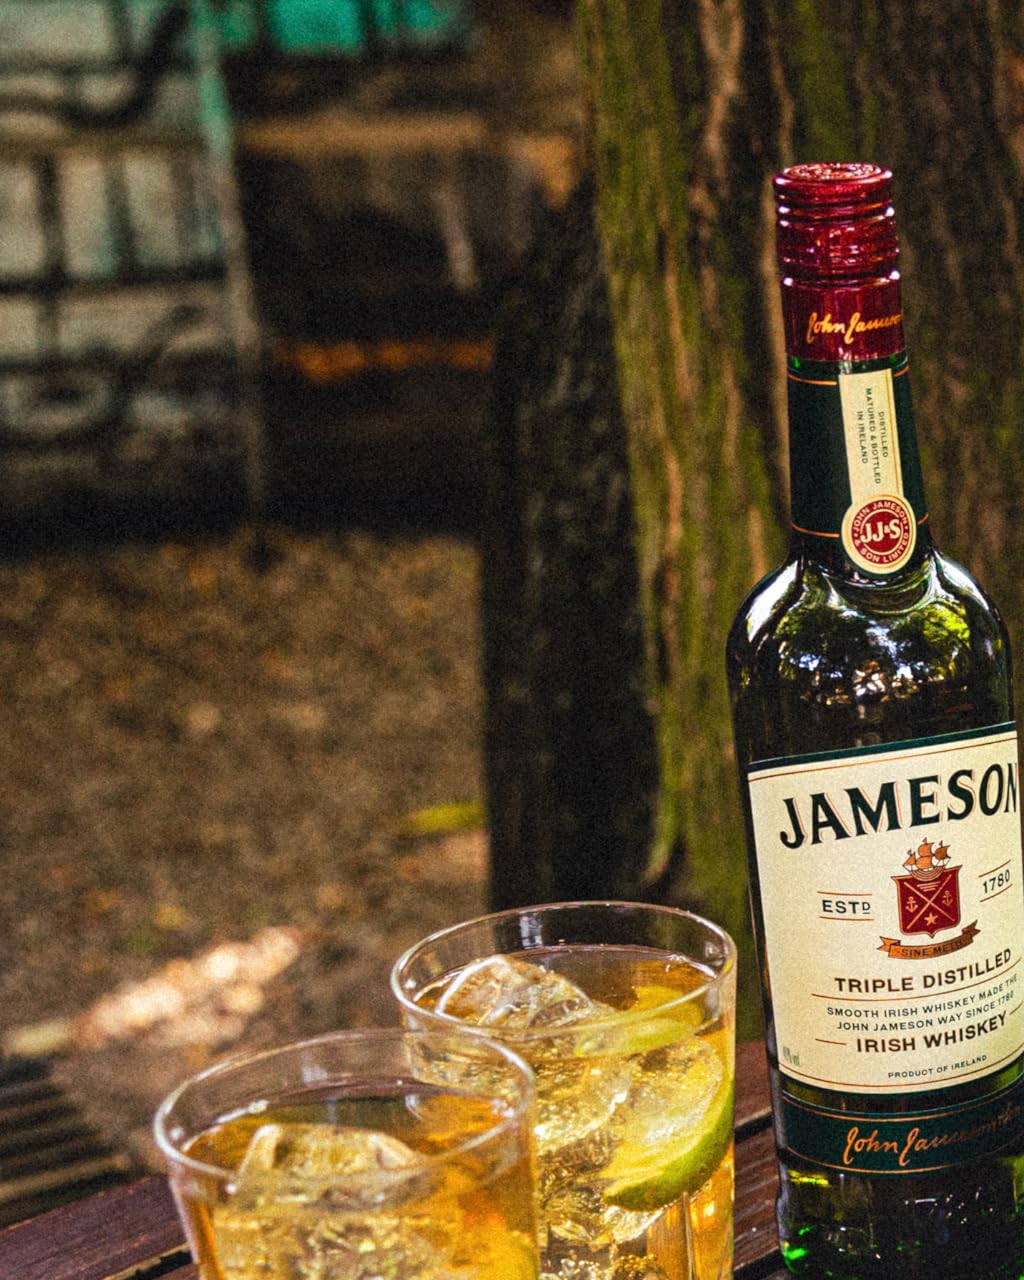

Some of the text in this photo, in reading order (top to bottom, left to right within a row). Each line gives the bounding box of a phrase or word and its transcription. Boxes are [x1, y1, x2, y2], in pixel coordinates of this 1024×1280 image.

[806, 312, 845, 345] John
[858, 423, 869, 464] IRELAND
[865, 388, 877, 432] MATURED
[871, 443, 882, 485] BOTTLED
[878, 411, 889, 458] DISTILLED
[853, 501, 909, 532] JOHN JAMESON
[860, 548, 881, 563] SON
[882, 532, 910, 563] LIMITED
[779, 762, 1017, 850] JAMESON
[981, 868, 1011, 894] 1780
[834, 948, 1012, 993] TRIPLE DISTILLED
[827, 973, 1018, 1018] SMOOTH IRISH WHISKEY MADE THE
[837, 989, 1015, 1032] JOHN JAMESON WAY SINCE 1780
[856, 1010, 1008, 1053] IRISH WHISKEY
[887, 1054, 988, 1079] PRODUCT OF IRELAND
[843, 1127, 899, 1166] John
